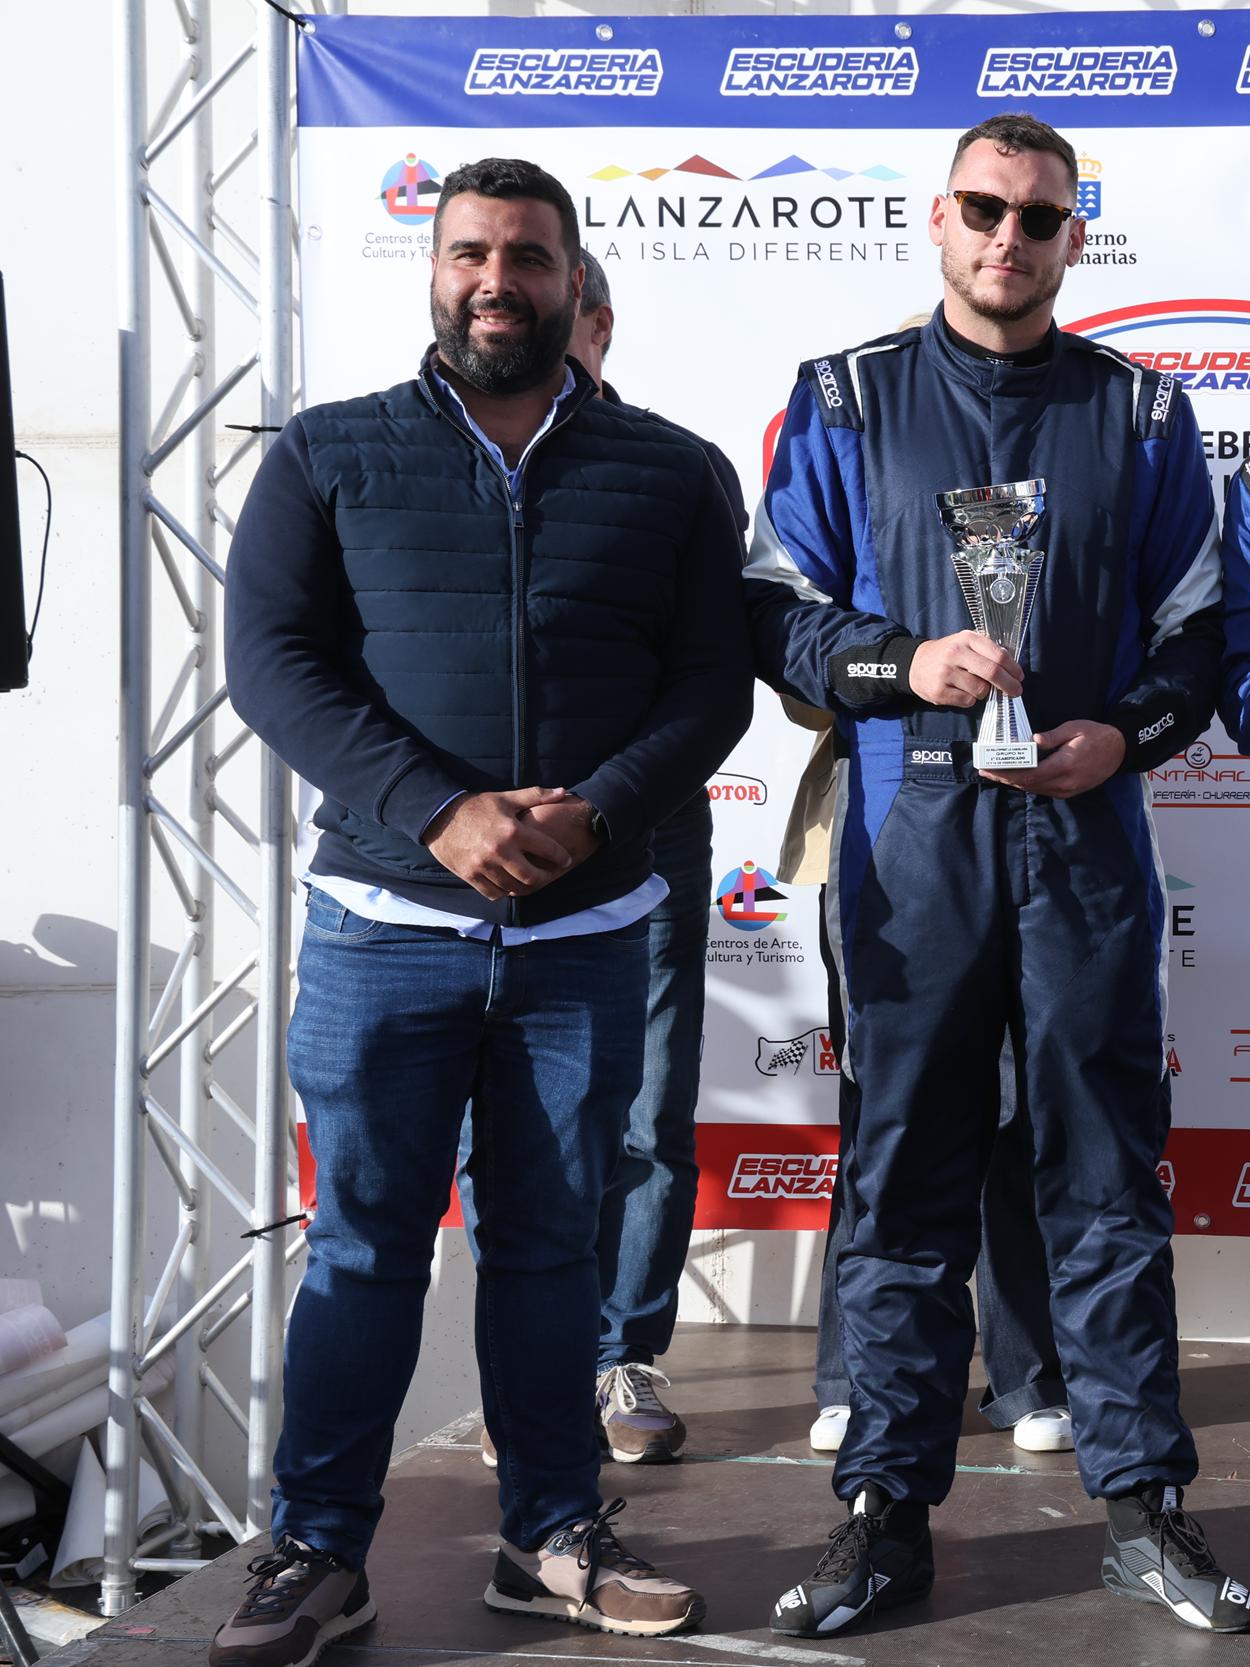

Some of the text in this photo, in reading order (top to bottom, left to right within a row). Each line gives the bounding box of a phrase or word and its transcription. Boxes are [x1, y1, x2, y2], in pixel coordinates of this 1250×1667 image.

[475, 53, 659, 72] ESCUDERIA
[731, 52, 915, 72] ESCUDERIA
[987, 51, 1173, 72] ESCUDERIA
[469, 73, 657, 91] LANZAROTE
[724, 73, 913, 91] LANZAROTE
[981, 72, 1172, 92] LANZAROTE
[585, 195, 908, 228] LANZAROTE
[365, 232, 431, 245] Centros de
[1085, 233, 1127, 246] erno
[362, 246, 406, 259] Cultura
[409, 249, 417, 262] y
[641, 242, 710, 261] ISLA
[729, 242, 909, 261] DIFERENTE
[1079, 249, 1137, 265] narias
[814, 360, 843, 408] sparco
[1151, 376, 1174, 422] sparco
[847, 663, 897, 678] sparco
[1138, 712, 1174, 744] sparco
[707, 785, 761, 801] OTOR
[1153, 789, 1196, 800] FETERÍA
[753, 938, 768, 949] de
[770, 938, 803, 950] Arte,
[706, 951, 805, 966] ultura y Turismo
